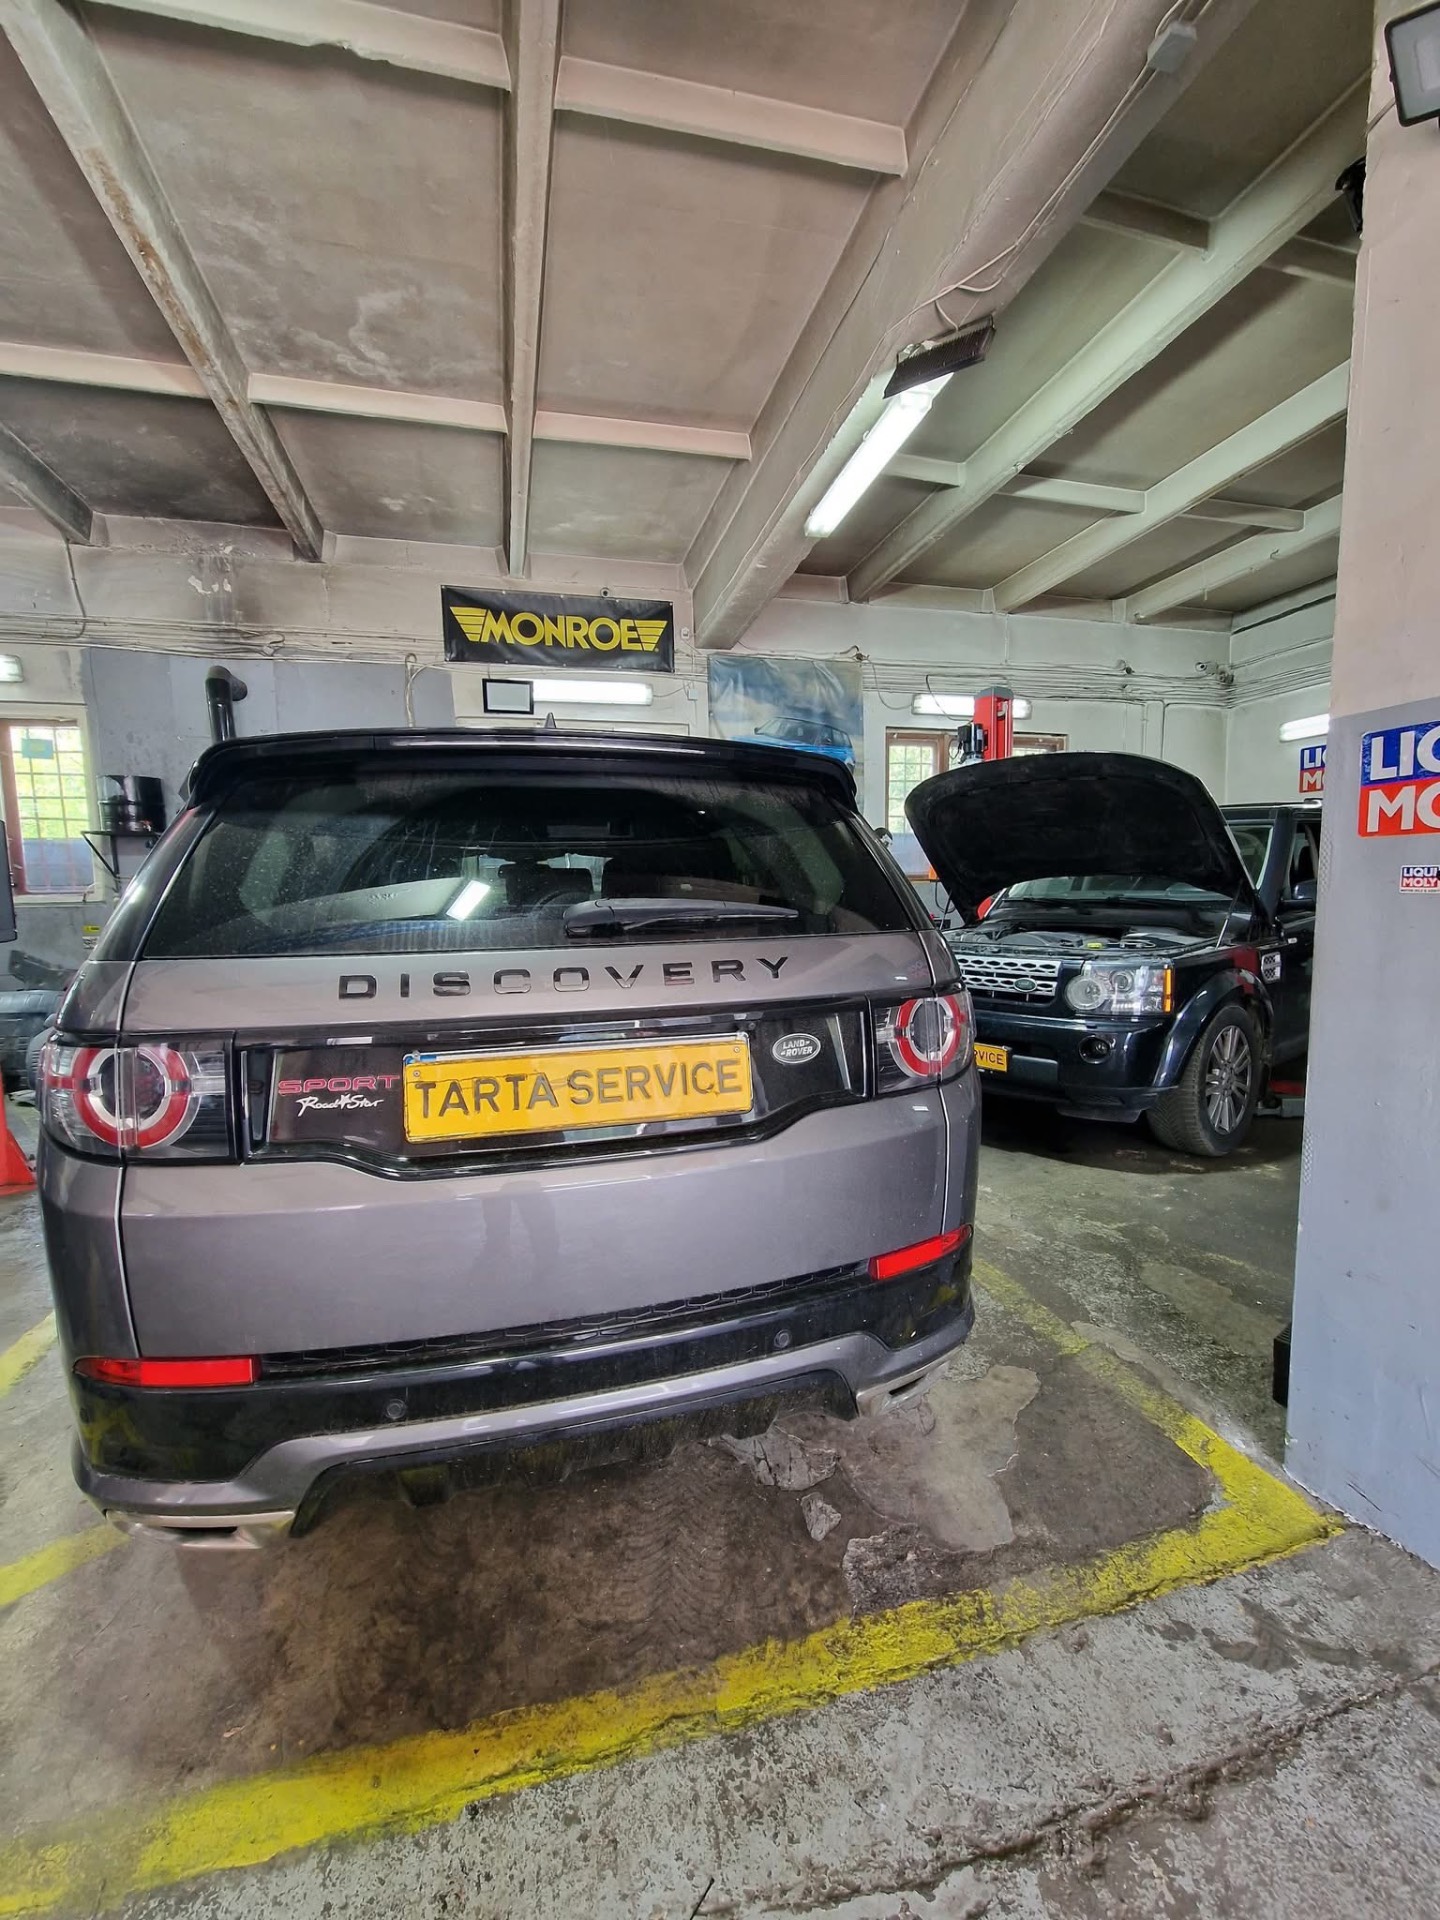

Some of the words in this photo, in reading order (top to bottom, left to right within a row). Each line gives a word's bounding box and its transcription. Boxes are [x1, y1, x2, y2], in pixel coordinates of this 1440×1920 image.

[480, 609, 644, 651] MONROE
[1303, 747, 1326, 769] LI
[1402, 877, 1438, 887] MOLY
[1403, 867, 1438, 877] LIQUI
[338, 956, 788, 999] DISCOVERY
[278, 1074, 400, 1095] SPORT
[415, 1072, 559, 1118] TARTA
[566, 1059, 743, 1106] SERVICE
